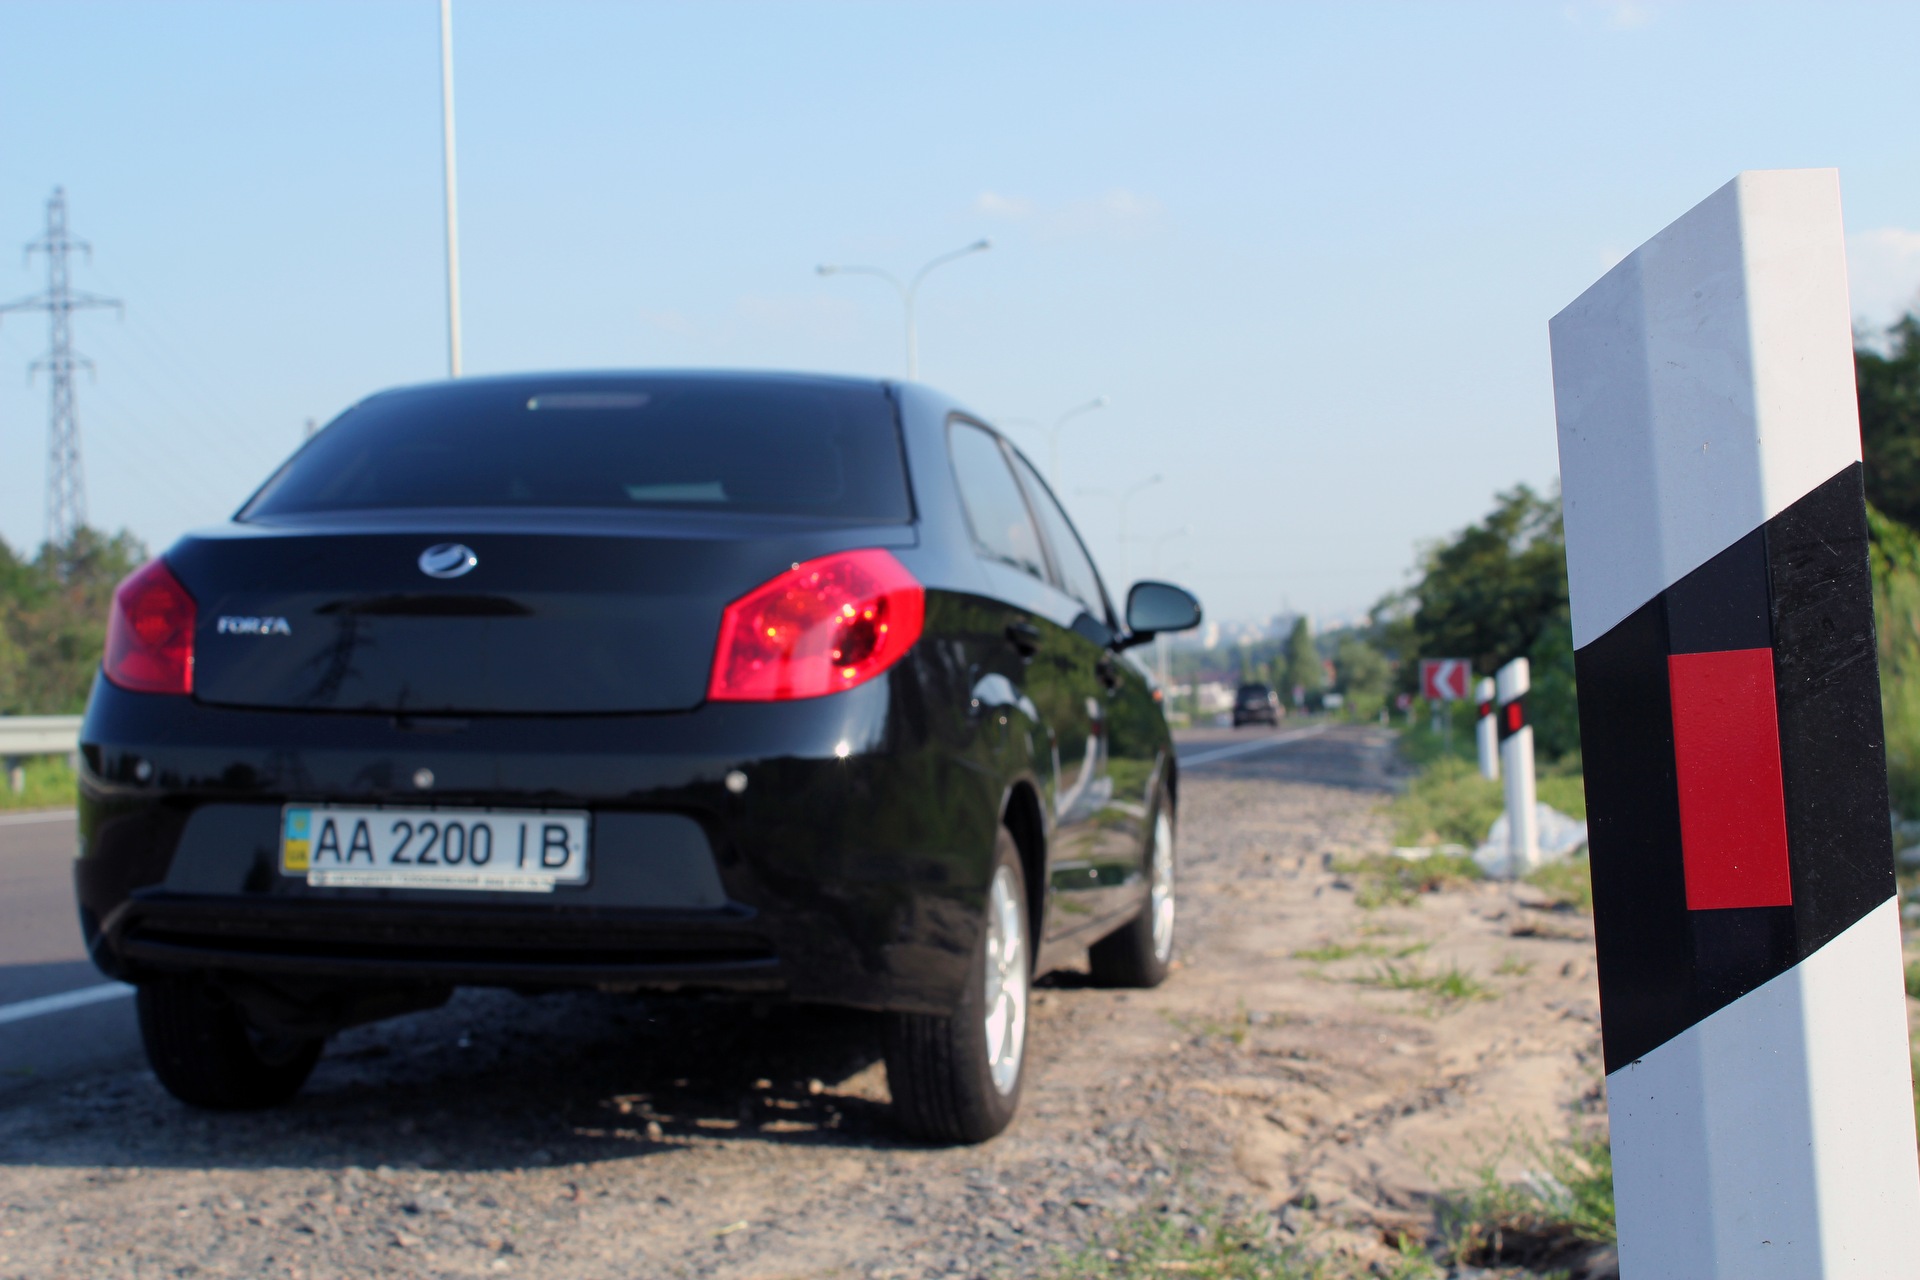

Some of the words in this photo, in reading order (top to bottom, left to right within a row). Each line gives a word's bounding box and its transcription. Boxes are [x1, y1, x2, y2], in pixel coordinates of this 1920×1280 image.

[217, 615, 291, 636] FORZA
[313, 818, 375, 865] AA
[389, 820, 493, 867] 2200
